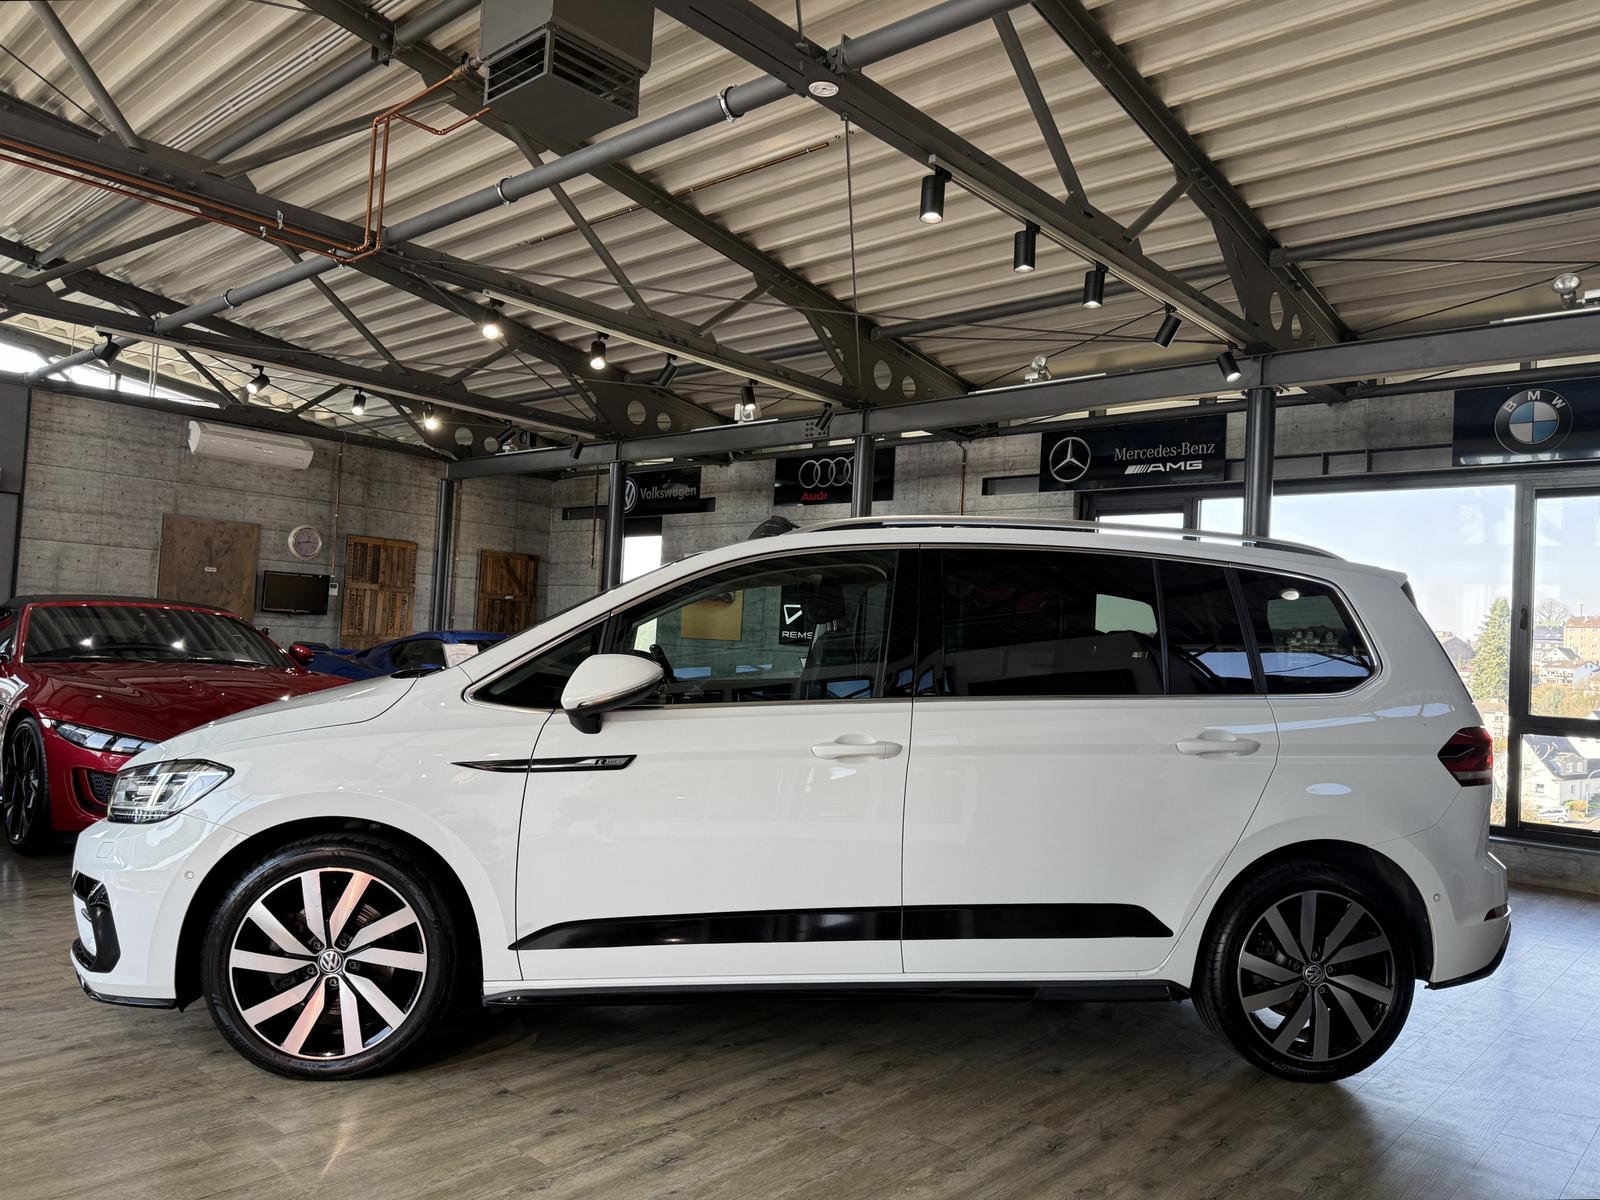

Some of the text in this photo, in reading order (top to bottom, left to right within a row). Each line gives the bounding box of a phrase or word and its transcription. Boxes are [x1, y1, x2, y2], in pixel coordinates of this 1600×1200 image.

[1503, 390, 1566, 413] BMW
[1114, 441, 1215, 461] Mercedes-Benz
[1147, 460, 1202, 473] AMG
[640, 486, 697, 500] Volkswagen
[801, 491, 828, 501] Audi
